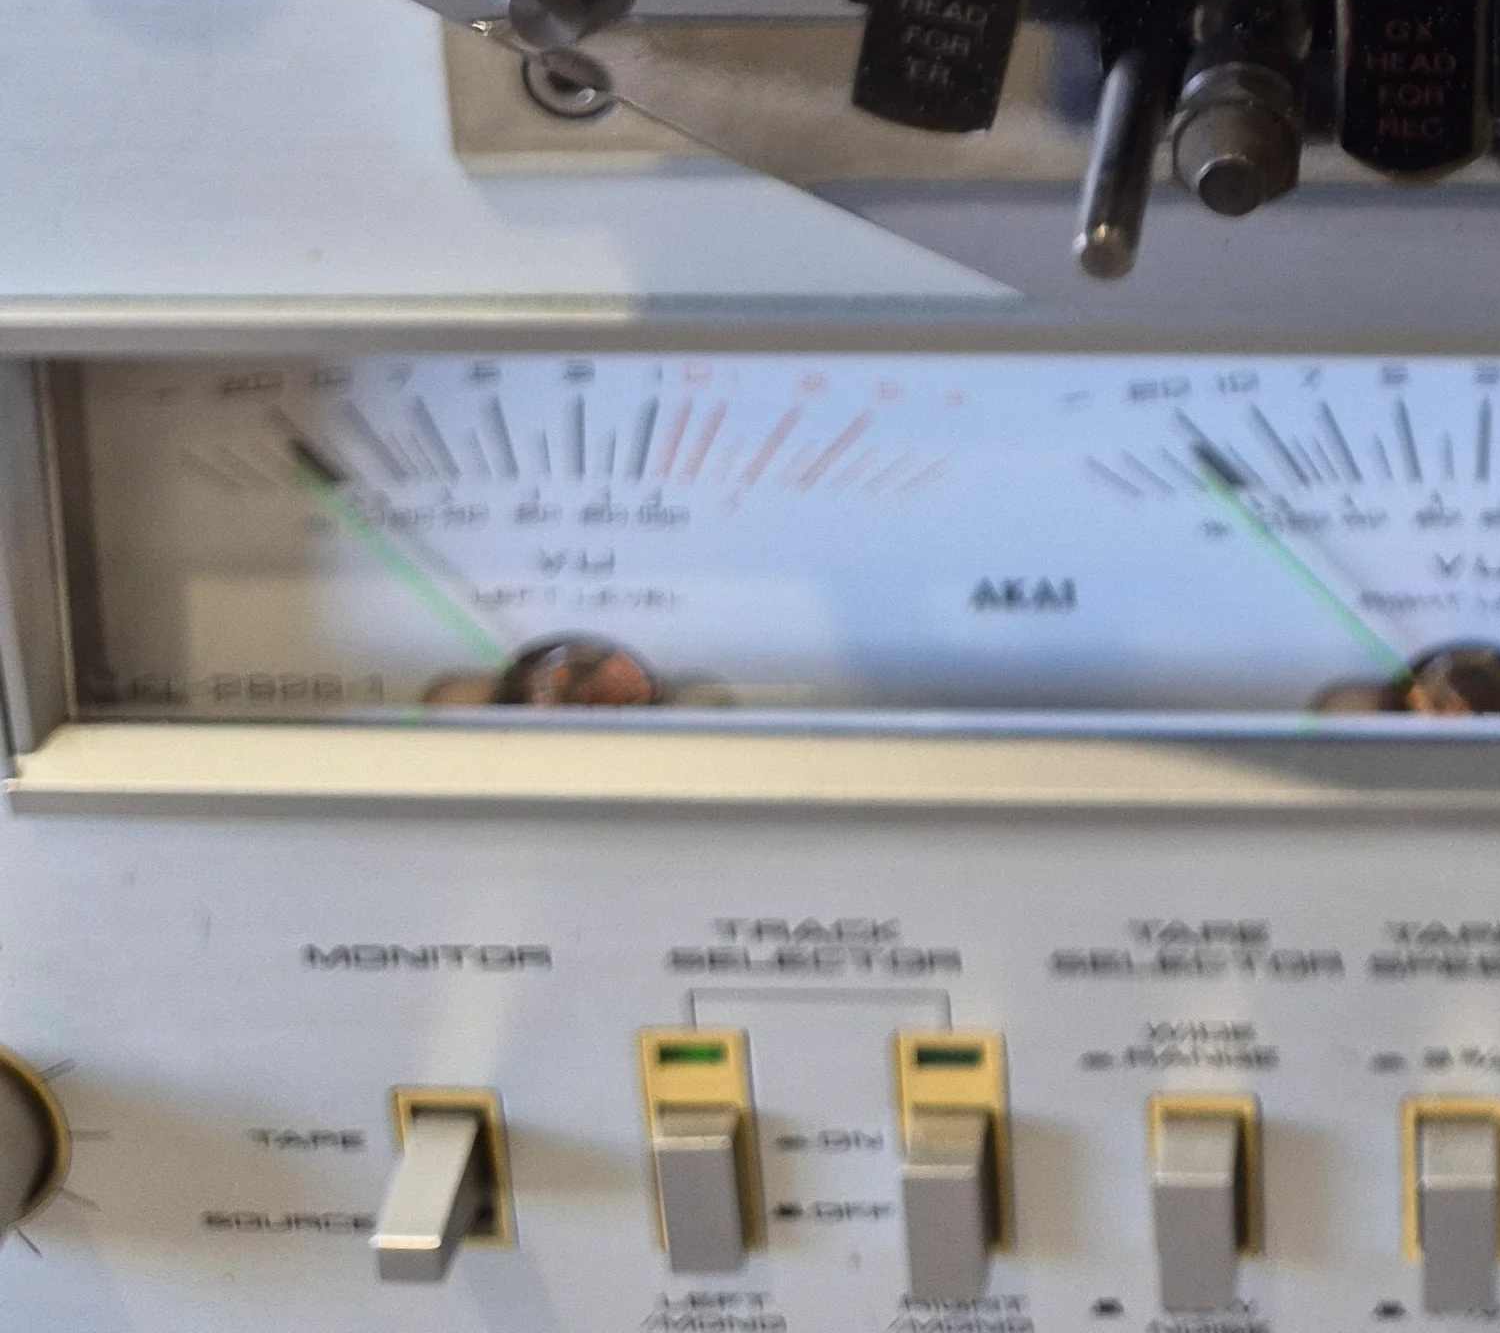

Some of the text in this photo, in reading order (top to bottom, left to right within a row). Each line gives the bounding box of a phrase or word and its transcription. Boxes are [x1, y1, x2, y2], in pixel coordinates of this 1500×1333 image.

[1364, 52, 1457, 74] HEAD
[969, 575, 1078, 611] AKAI
[714, 917, 900, 942] TRACK
[1127, 917, 1270, 944] TAPE
[303, 943, 552, 971] MONITOR
[668, 946, 963, 974] SELECTOR
